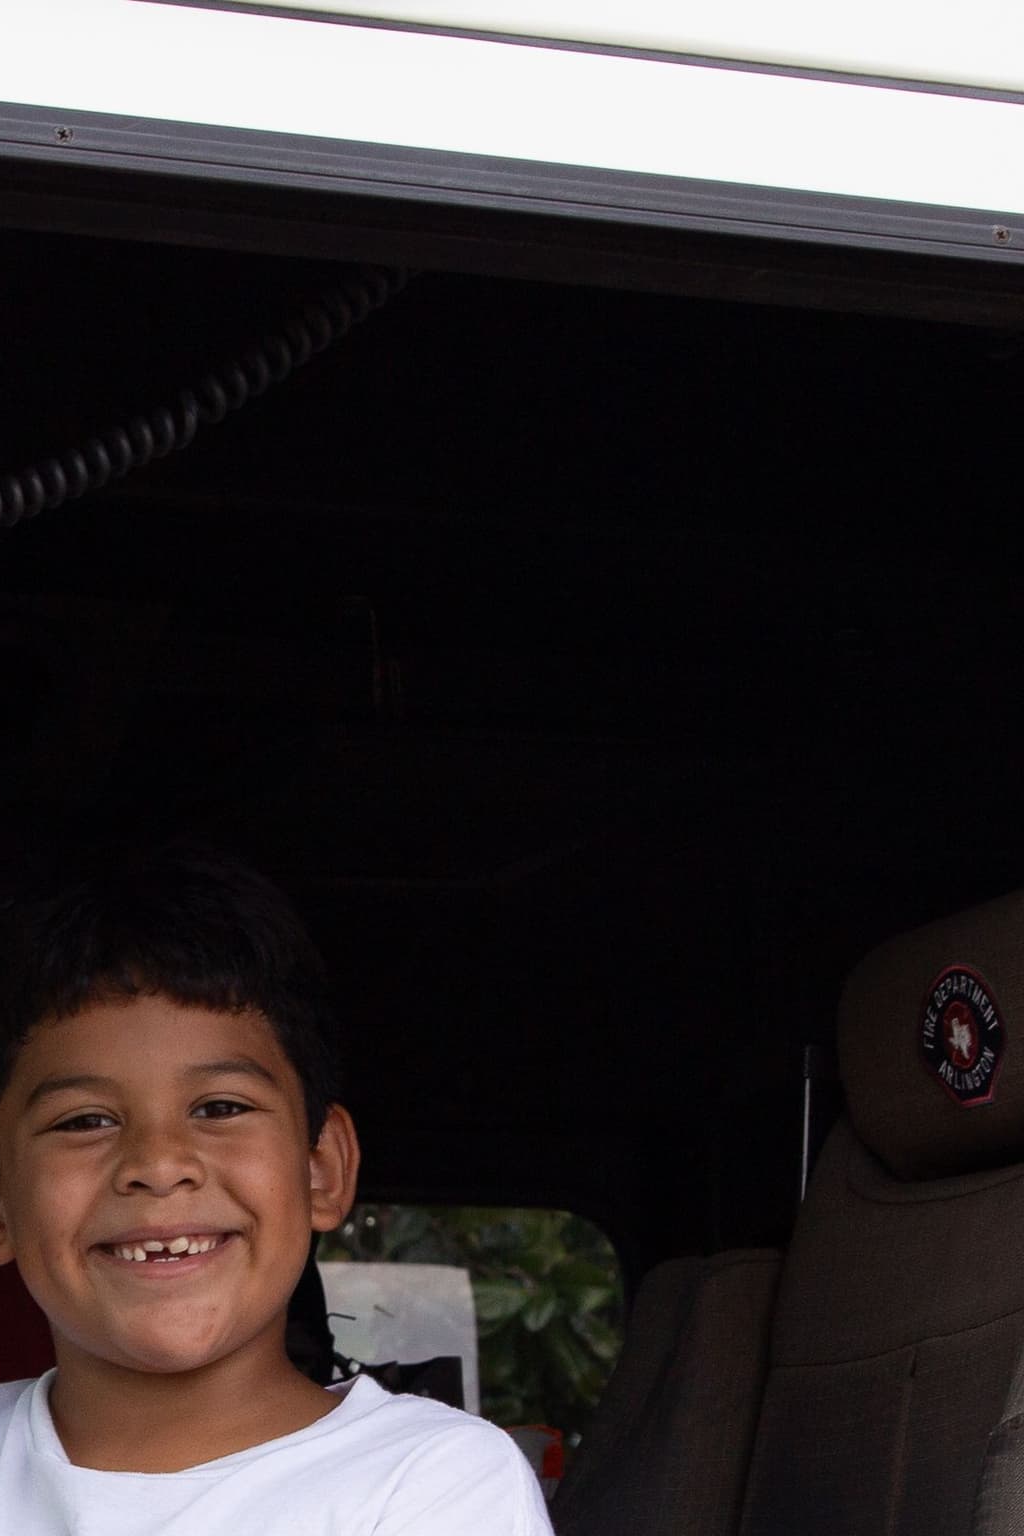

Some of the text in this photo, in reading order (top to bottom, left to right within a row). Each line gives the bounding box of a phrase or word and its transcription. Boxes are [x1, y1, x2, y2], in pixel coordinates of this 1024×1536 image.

[923, 975, 999, 1049] FIRE DEPARTMENT
[937, 1046, 995, 1090] ARLINGTON
